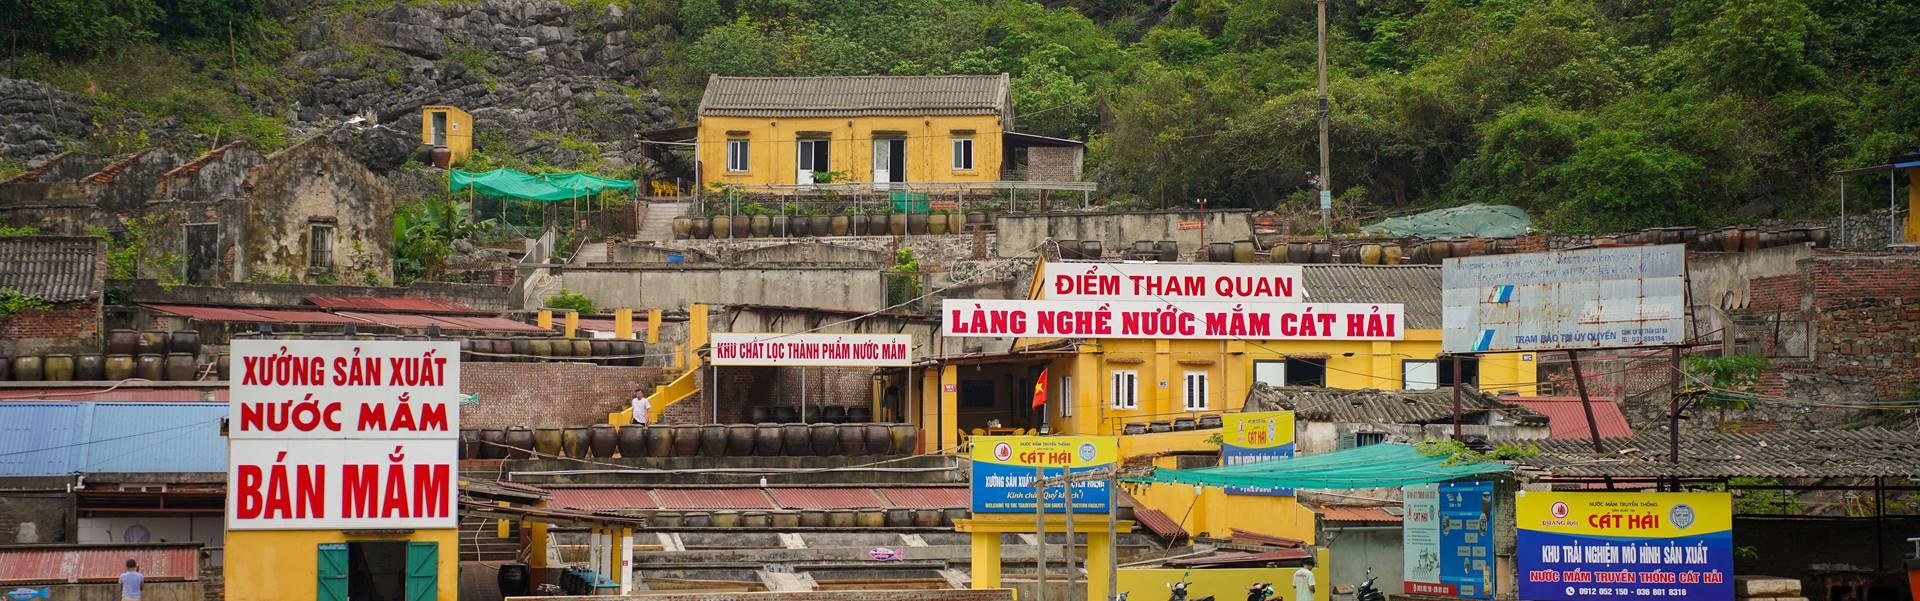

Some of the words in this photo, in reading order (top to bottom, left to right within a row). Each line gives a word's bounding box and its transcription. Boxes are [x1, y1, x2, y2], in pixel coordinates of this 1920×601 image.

[1055, 265, 1120, 296] ĐIỂM
[1129, 275, 1206, 296] THAM
[1214, 276, 1293, 298] QUAN
[951, 303, 1027, 334] LÀNG
[1037, 303, 1112, 335] NGHỀ
[1121, 303, 1195, 335] NƯỚC
[1205, 303, 1271, 336] MẮM
[1280, 306, 1337, 337] CÁT
[1346, 305, 1396, 337] HẢI
[717, 342, 736, 359] KHU
[739, 337, 764, 359] CHẤT
[766, 342, 785, 362] LỌC
[787, 340, 819, 359] THÀNH
[822, 336, 850, 360] PHẨM
[853, 340, 879, 360] NƯỚC
[881, 338, 906, 360] MẮM
[242, 346, 325, 386] XƯỞNG
[332, 347, 381, 386] SẢN
[389, 349, 447, 386] XUẤT
[240, 393, 342, 432] NƯỚC
[357, 392, 449, 432] MẮM
[1020, 450, 1045, 464] CÁT
[1048, 449, 1072, 464] HẢI
[236, 451, 326, 519] BÁN
[341, 445, 450, 518] MẮM
[1588, 512, 1623, 529] CÁT
[1628, 511, 1659, 529] HẢI
[1542, 545, 1560, 563] KHU
[1563, 540, 1582, 563] TRẢI
[1585, 542, 1619, 567] NGHIỆM
[1622, 542, 1636, 563] MÔ
[1640, 542, 1661, 563] HÌNH
[1664, 540, 1682, 564] SẢN
[1685, 540, 1708, 564] XUẤT
[1530, 568, 1560, 582] NƯỚC
[1563, 567, 1591, 582] MẮM
[1595, 568, 1636, 583] TRUYỀN
[1639, 568, 1675, 583] THỐNG
[1679, 569, 1700, 583] CÁT
[1703, 568, 1723, 583] HẢI
[1668, 588, 1687, 596] 8318
